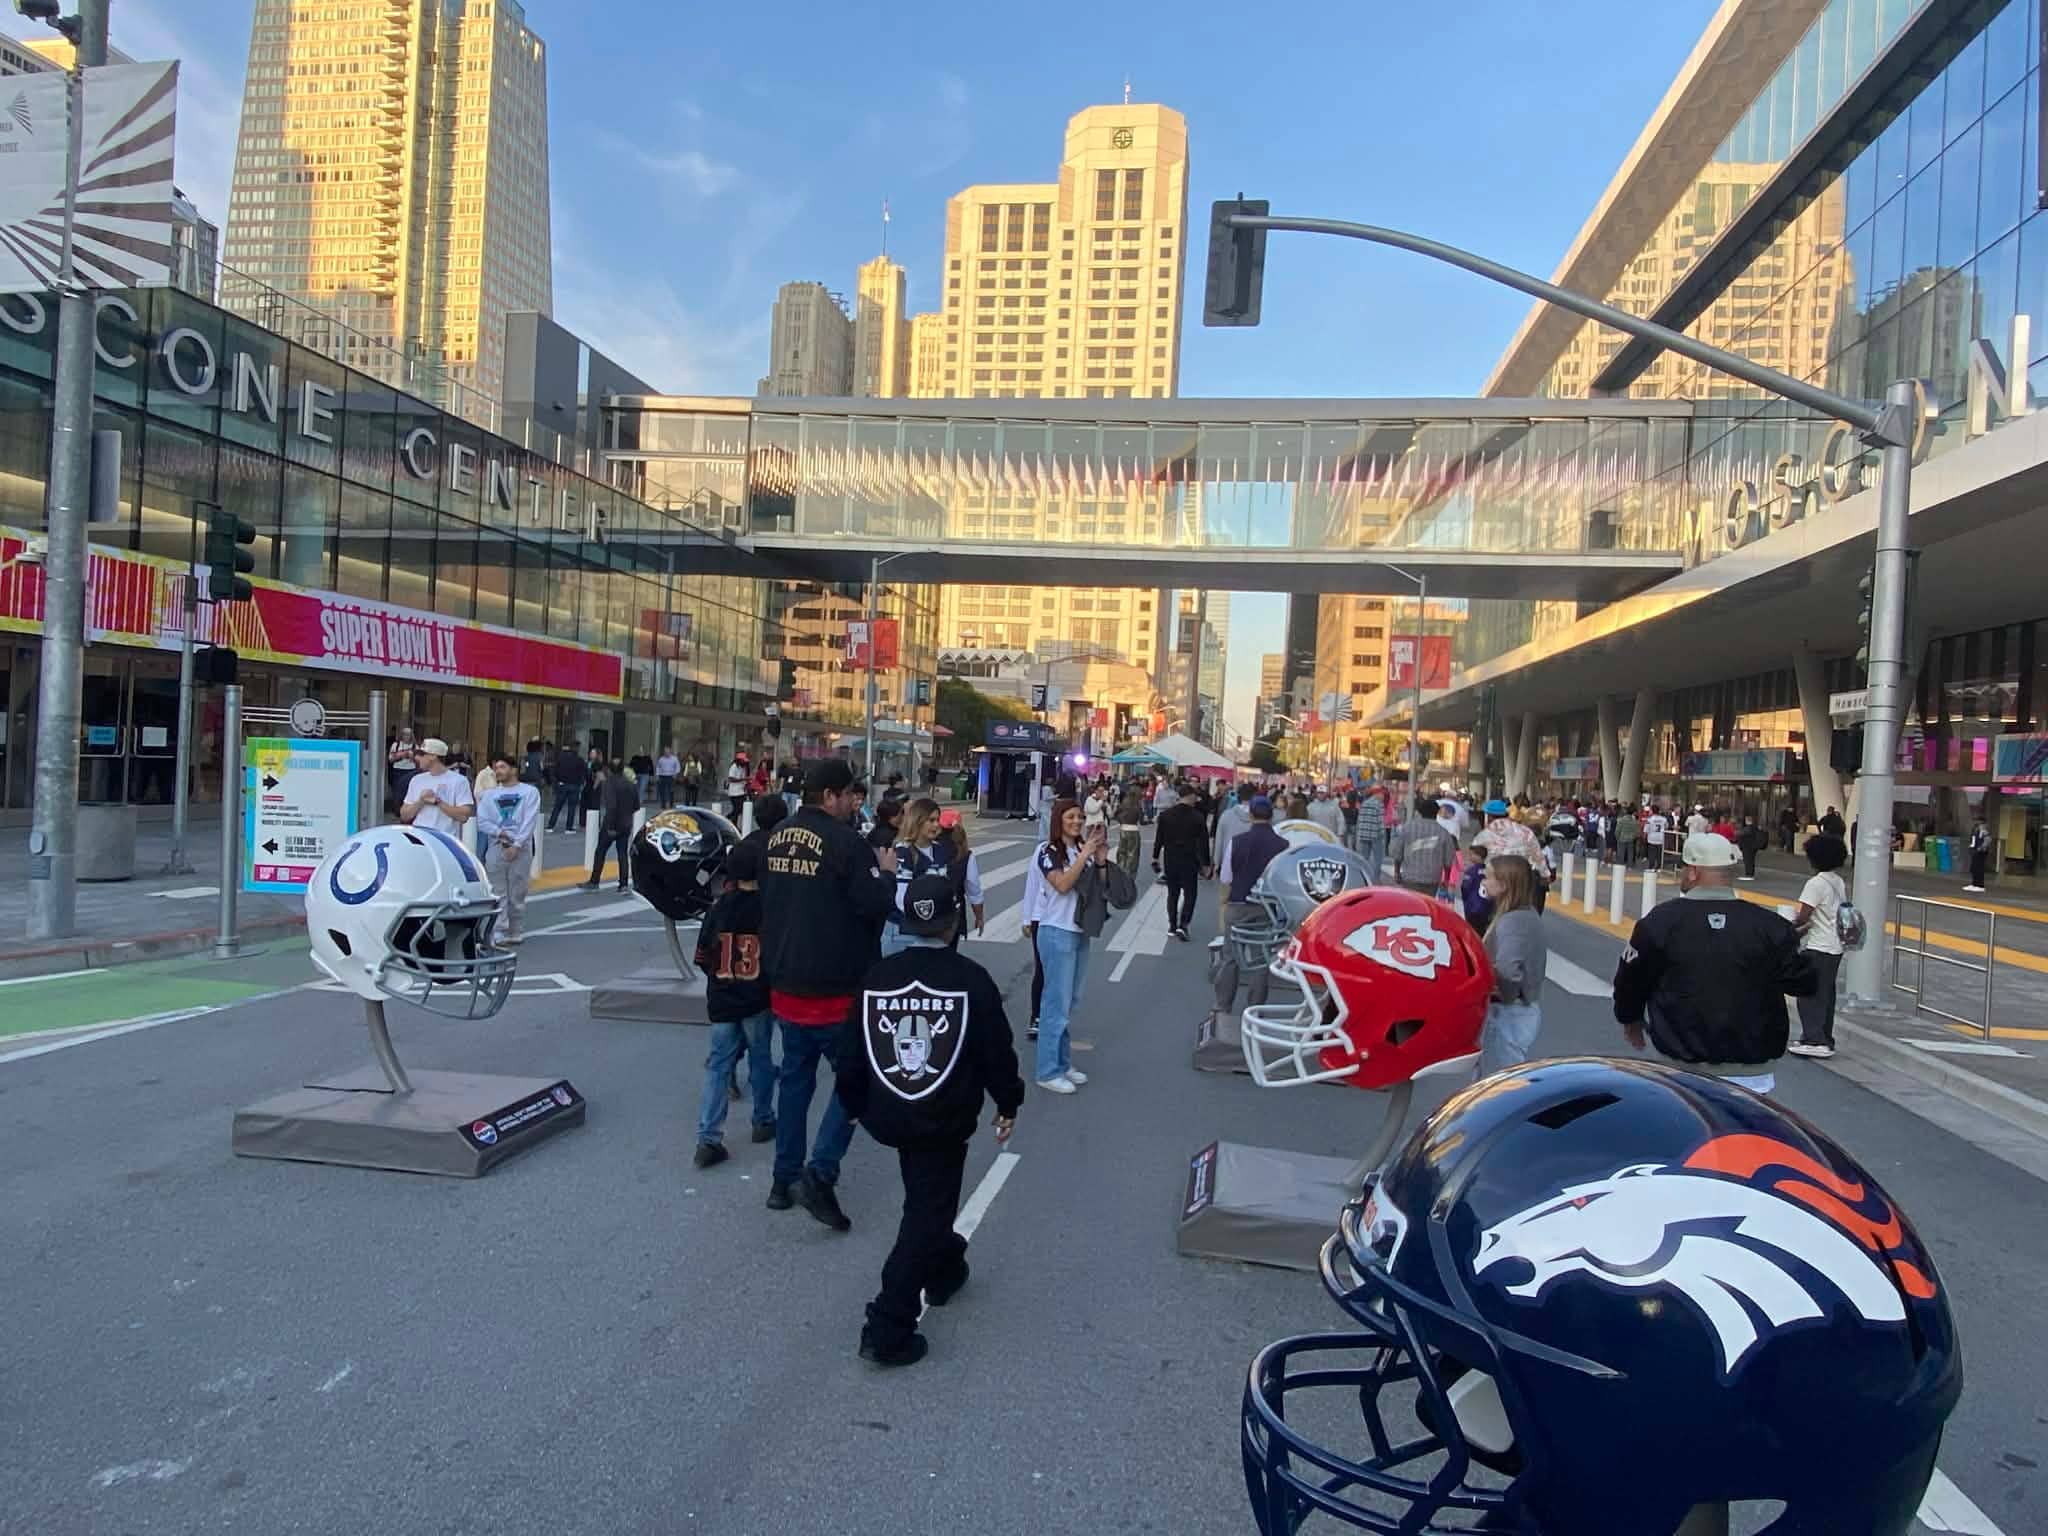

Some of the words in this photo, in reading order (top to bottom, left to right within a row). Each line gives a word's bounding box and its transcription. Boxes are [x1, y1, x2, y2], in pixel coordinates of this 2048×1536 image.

[320, 608, 385, 658] SUPER
[387, 620, 436, 665] BOWL
[436, 630, 457, 668] LX
[767, 827, 823, 857] FAITHFUL
[767, 857, 790, 873] THE
[792, 860, 819, 877] BAY
[716, 932, 761, 981] 13
[1373, 926, 1435, 966] KC
[876, 998, 955, 1011] RAIDERS
